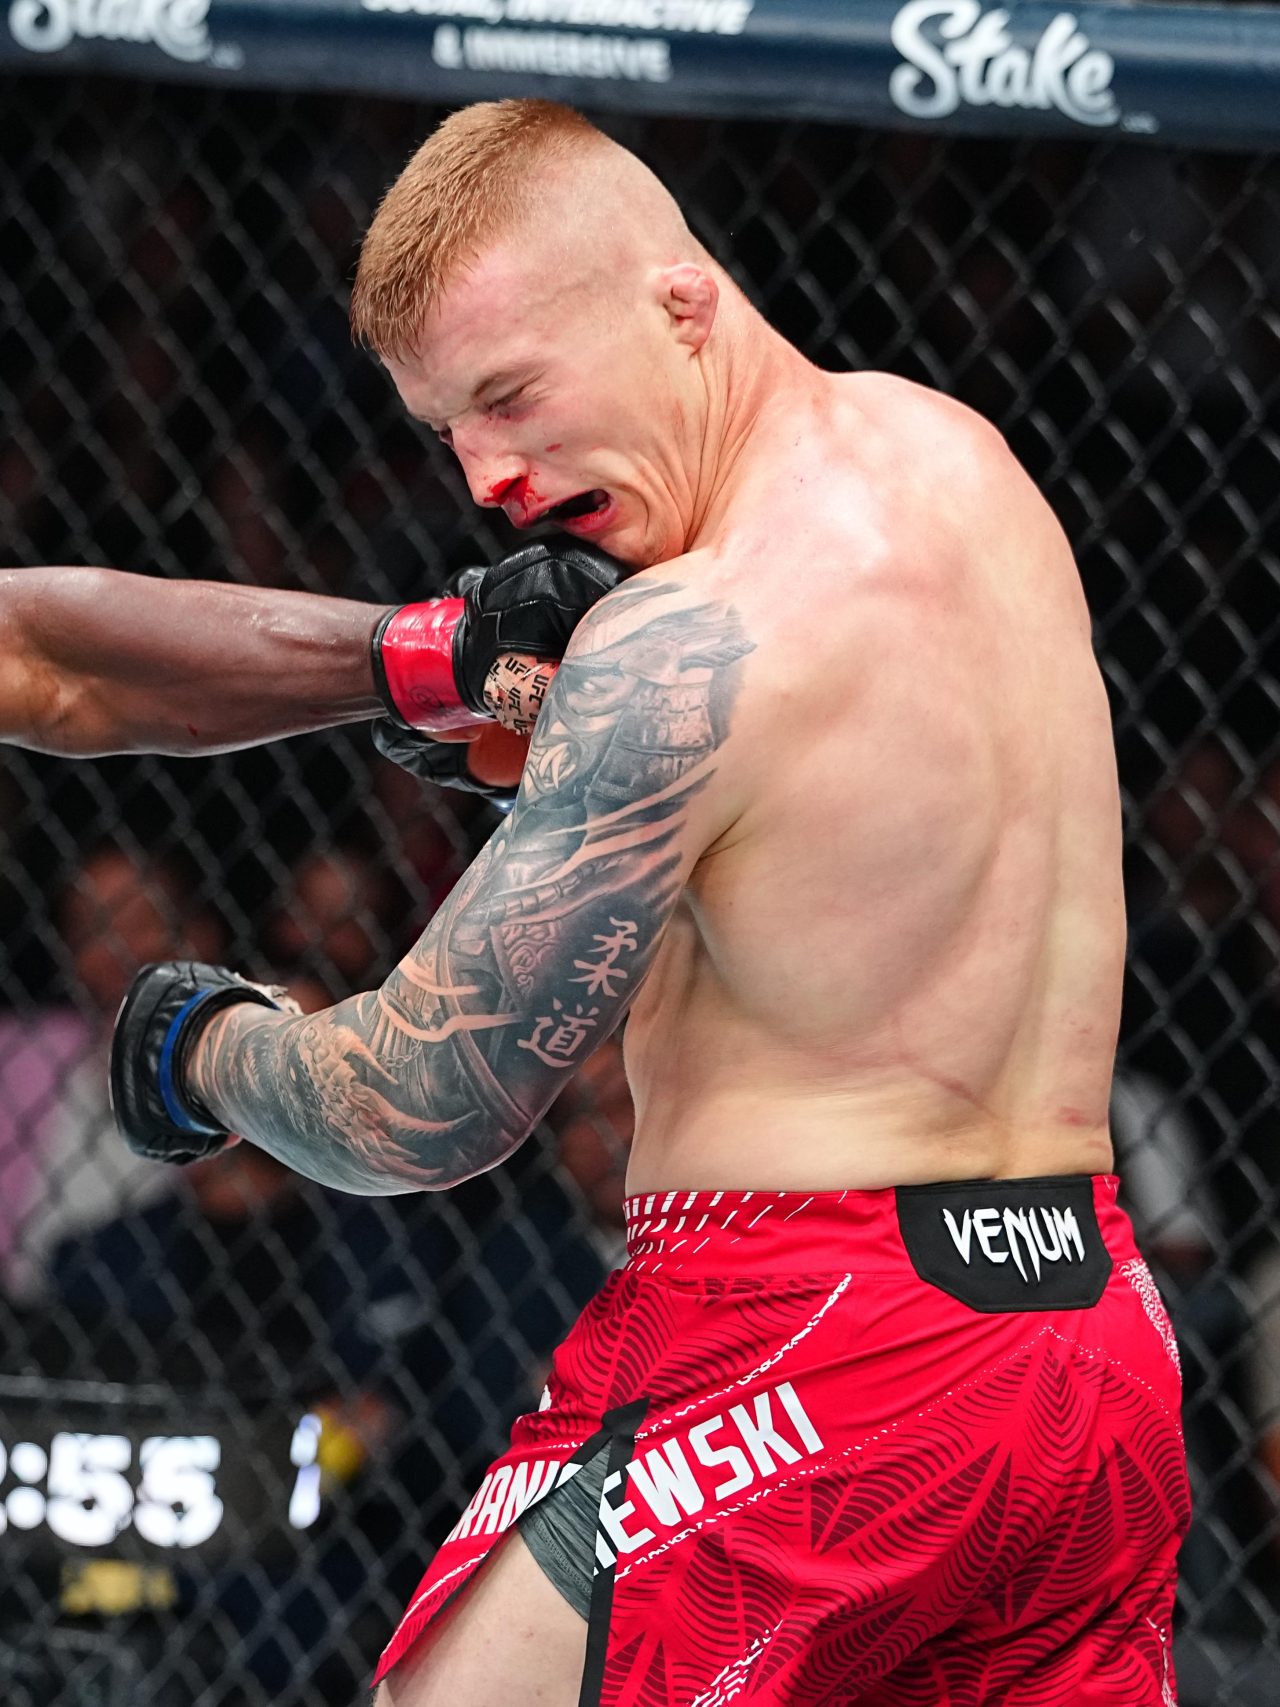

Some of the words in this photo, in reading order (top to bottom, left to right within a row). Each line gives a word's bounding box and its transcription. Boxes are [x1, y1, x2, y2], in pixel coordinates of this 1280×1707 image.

[890, 0, 1120, 126] Stake
[517, 916, 639, 1068] 柔道
[942, 1206, 1085, 1283] VENUM
